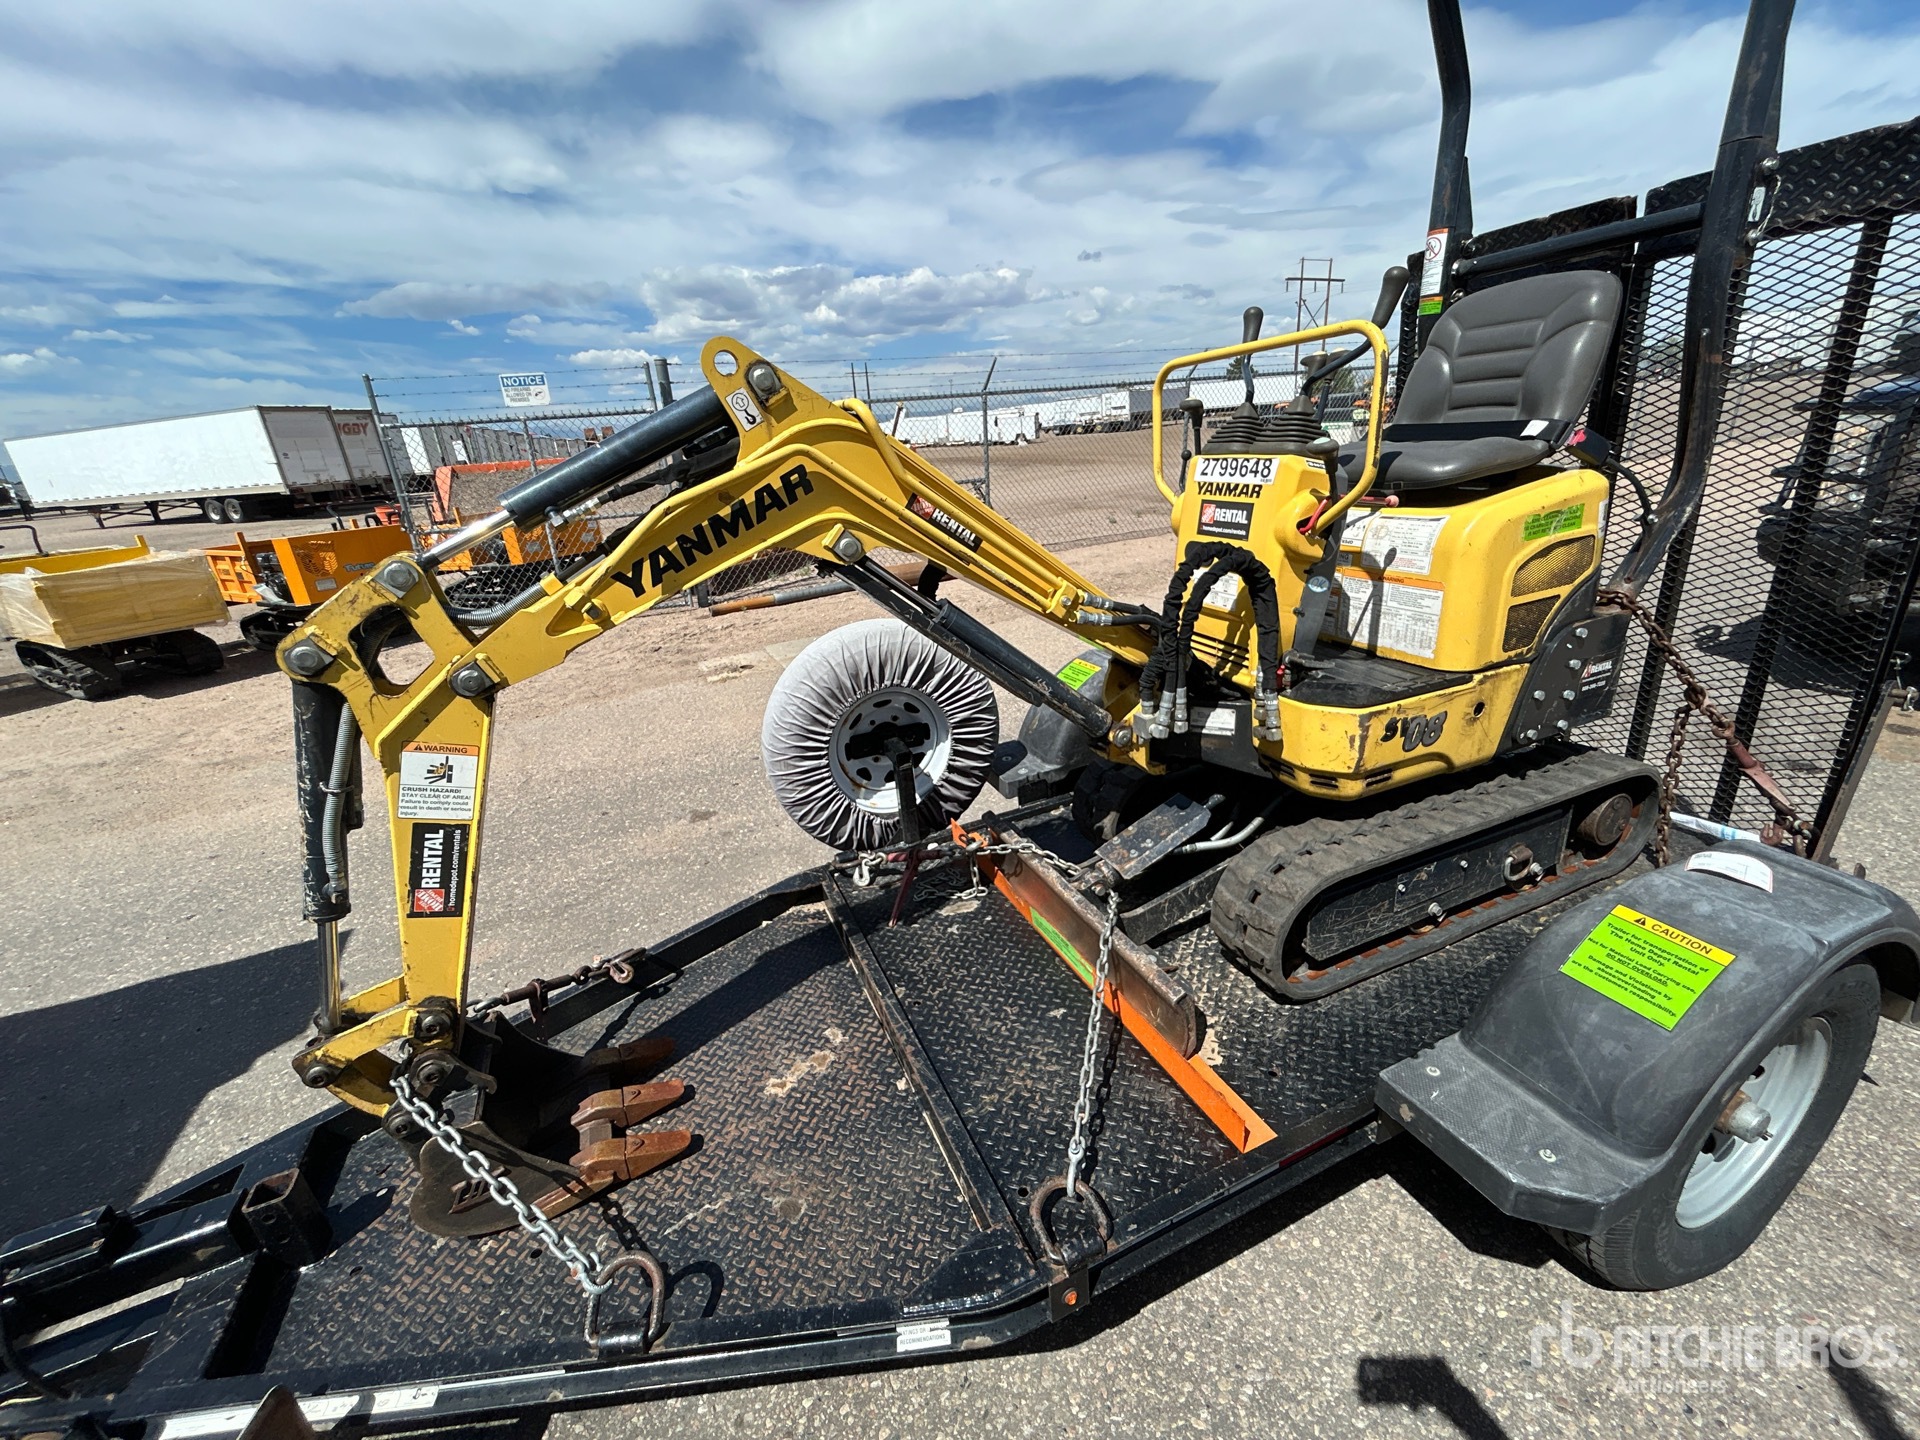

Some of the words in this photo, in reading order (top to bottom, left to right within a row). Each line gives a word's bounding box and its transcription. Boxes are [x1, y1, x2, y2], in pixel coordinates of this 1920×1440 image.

[503, 376, 543, 386] NOTICE
[1200, 458, 1272, 479] 2799648
[1198, 482, 1263, 498] YANMAR
[611, 464, 814, 598] YANMAR
[931, 508, 976, 546] RENTAL
[1214, 508, 1248, 524] RENTAL
[424, 745, 468, 753] WARNING
[421, 830, 444, 888] RENTAL
[448, 830, 462, 906] homedepot.com/rentals
[1608, 922, 1630, 936] Trailer
[1643, 940, 1698, 968] transportation
[1610, 930, 1623, 939] The
[1625, 938, 1646, 950] Home
[1648, 948, 1671, 962] Depot
[1672, 960, 1700, 976] Rental
[1652, 924, 1712, 955] CAUTION
[1609, 948, 1635, 962] Material
[1636, 961, 1652, 971] Load
[1652, 969, 1681, 986] Carrying
[1617, 958, 1631, 966] NOT
[1630, 947, 1646, 957] Unit
[1647, 956, 1665, 967] Only.
[1588, 955, 1614, 970] Damage
[1629, 976, 1662, 995] Violations
[1597, 967, 1656, 1000] abuse/overloading
[1594, 972, 1628, 991] customers
[1629, 990, 1676, 1017] responsibility.
[900, 1334, 945, 1344] RECOMMENDATIONS
